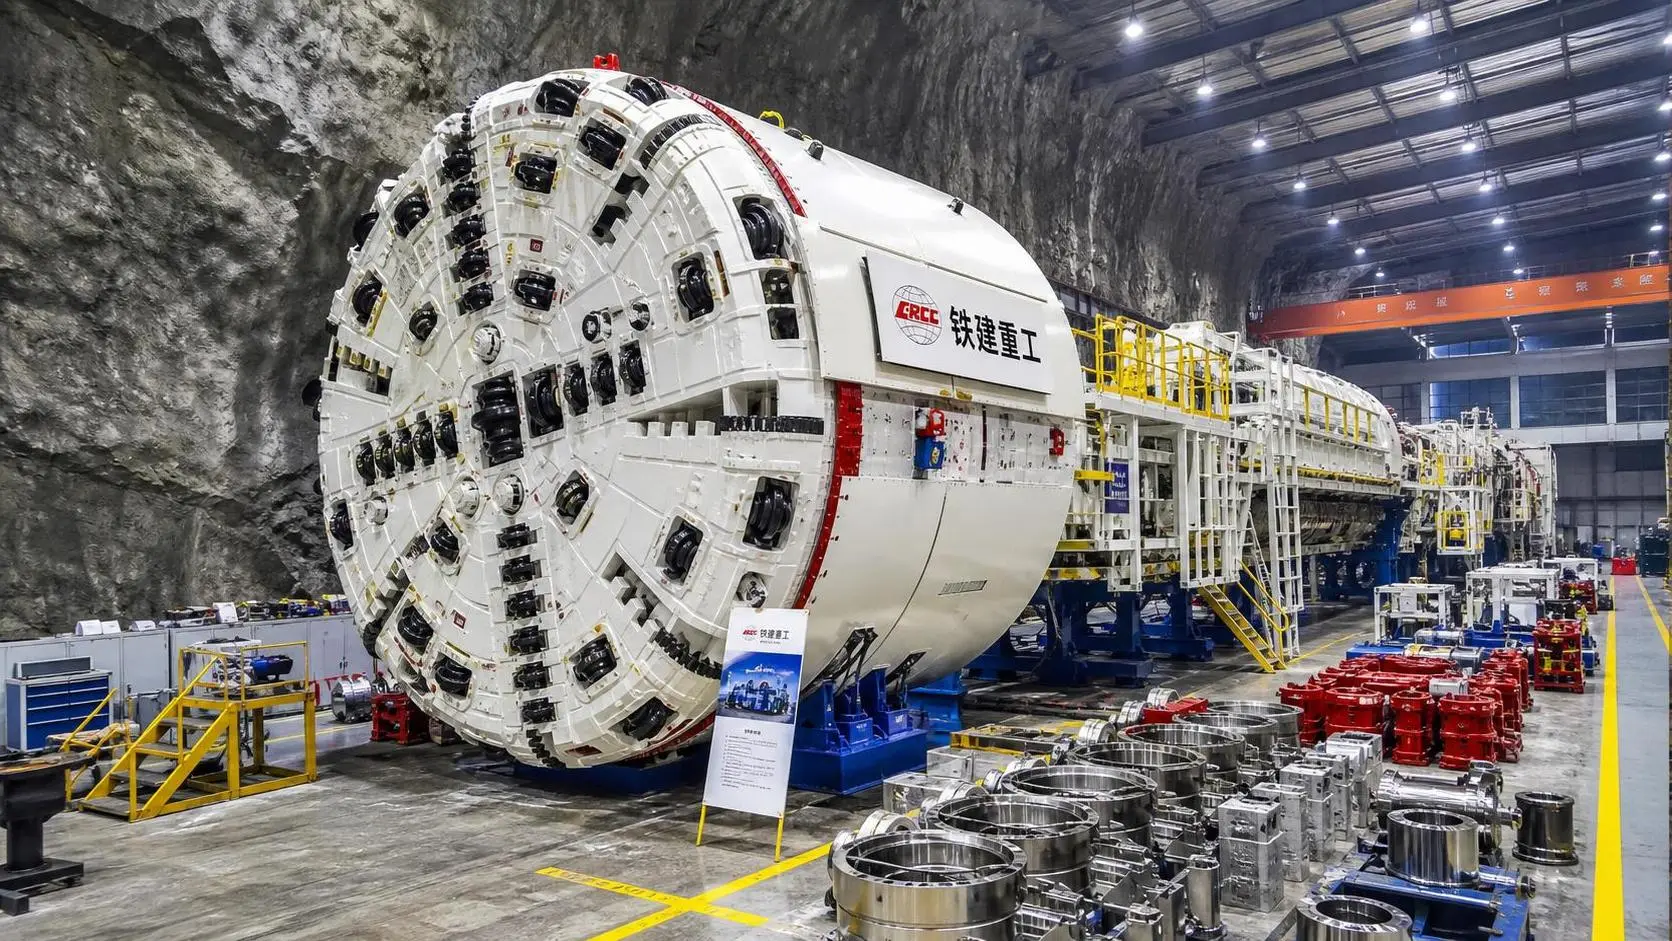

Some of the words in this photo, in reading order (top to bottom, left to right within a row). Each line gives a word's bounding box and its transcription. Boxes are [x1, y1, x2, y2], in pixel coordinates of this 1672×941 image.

[895, 300, 940, 325] CRCC
[949, 305, 1042, 363] 铁建重工
